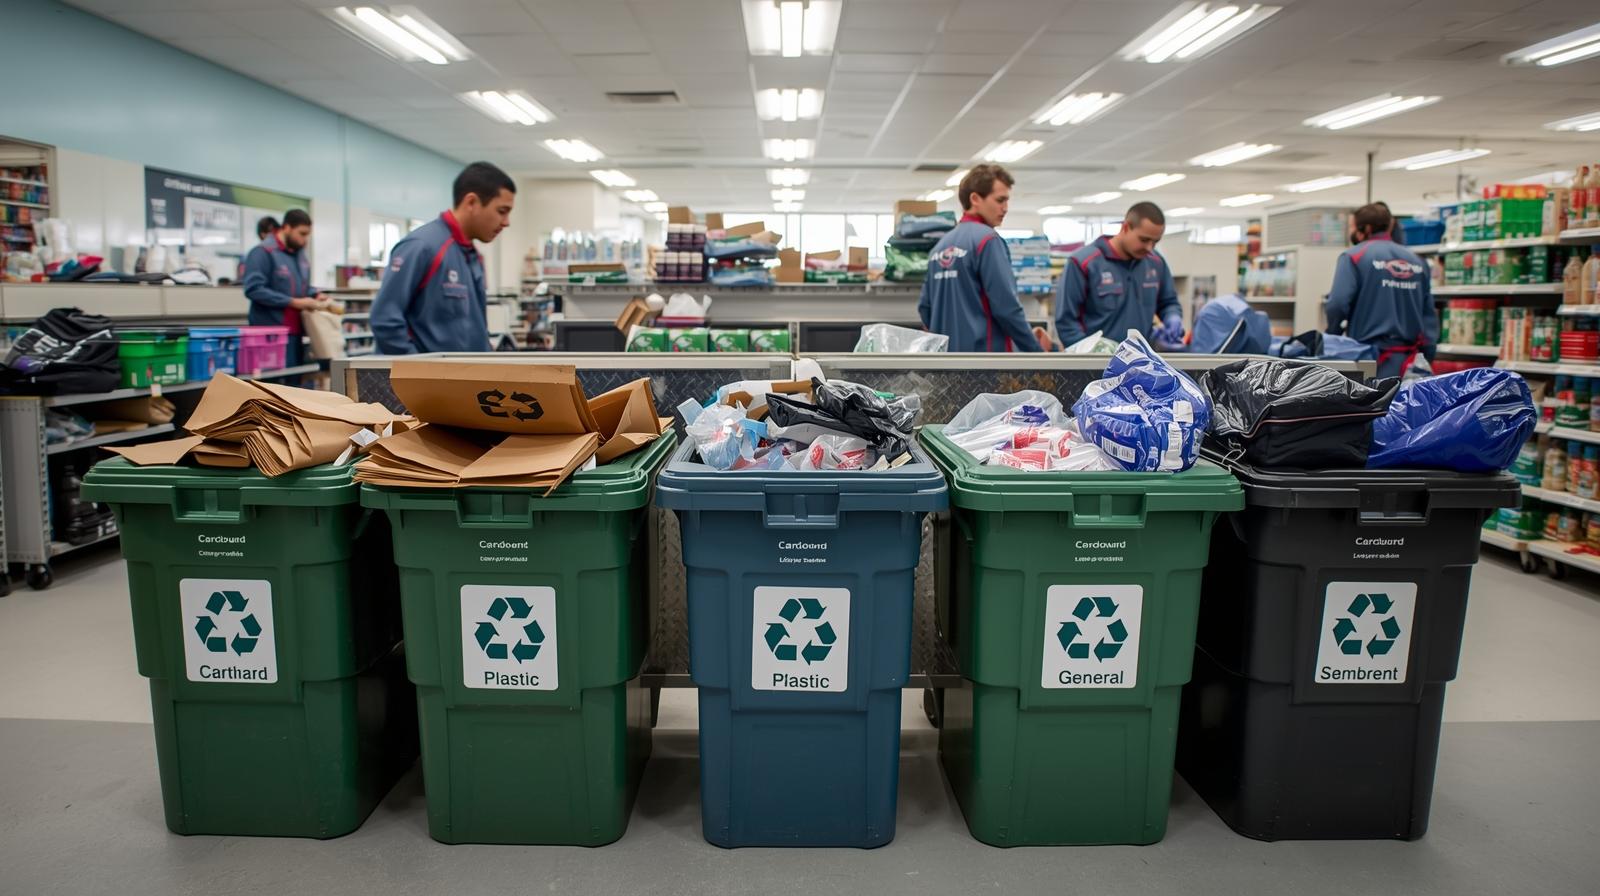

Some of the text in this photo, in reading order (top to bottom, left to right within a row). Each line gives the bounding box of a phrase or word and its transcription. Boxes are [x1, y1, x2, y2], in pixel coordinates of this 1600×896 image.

[199, 665, 268, 681] Carthard
[484, 671, 539, 686] Plastic
[772, 673, 830, 688] Plastic
[1058, 670, 1124, 685] General
[1320, 666, 1398, 681] Sembrent
